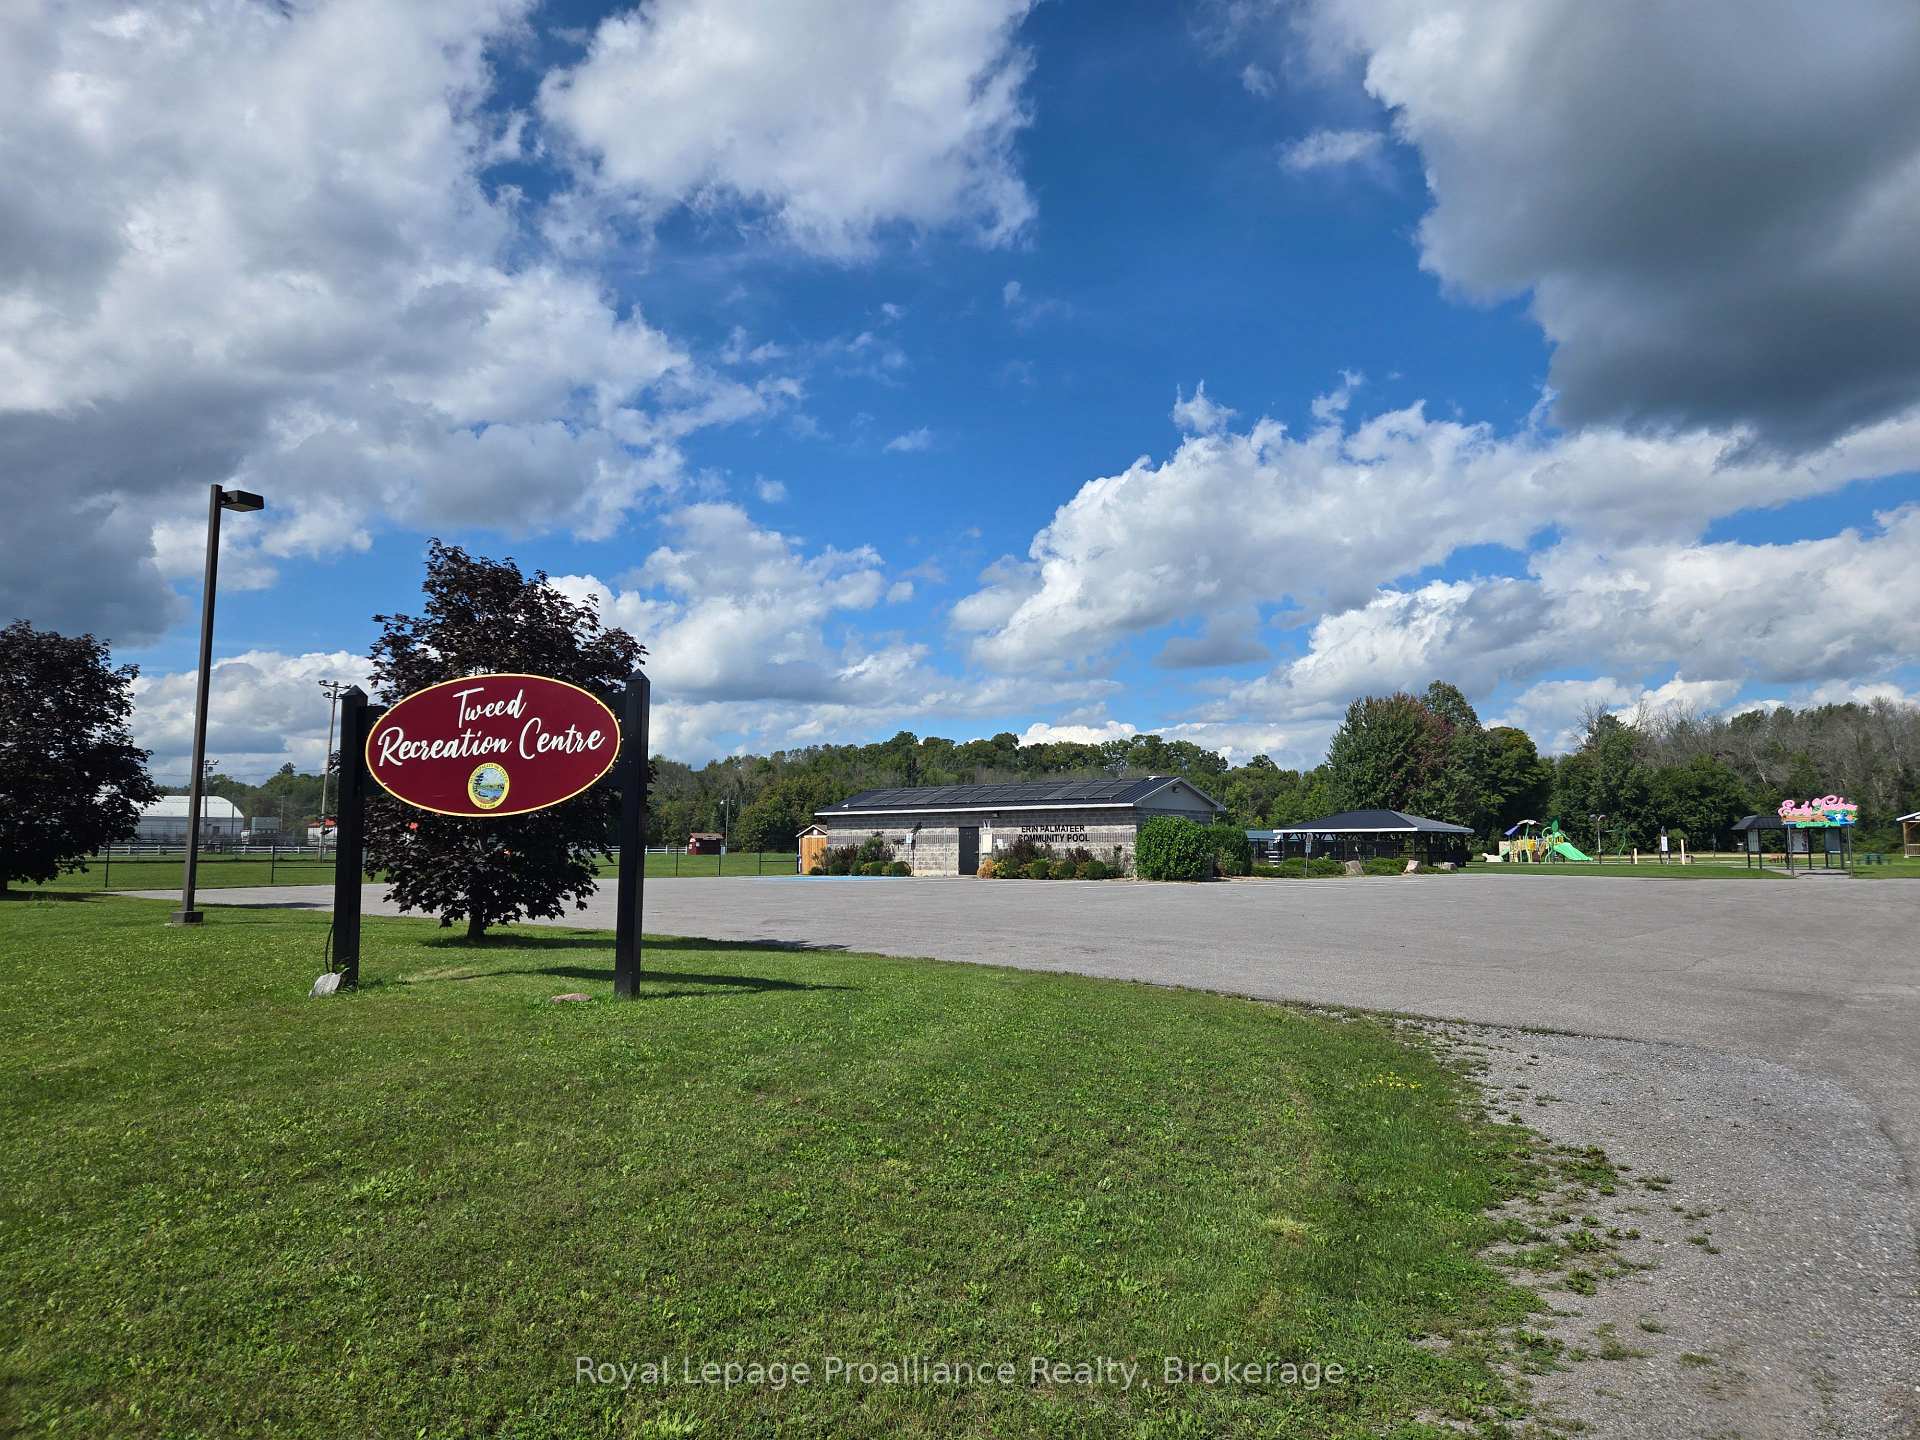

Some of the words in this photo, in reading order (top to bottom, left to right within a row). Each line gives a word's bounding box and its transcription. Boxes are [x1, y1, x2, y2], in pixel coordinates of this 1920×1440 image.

[453, 687, 526, 728] Tweed
[378, 726, 512, 767] Recreation
[519, 718, 605, 760] Centre
[1018, 834, 1065, 843] COMMUNITY
[1067, 834, 1090, 842] POOL
[1040, 825, 1085, 833] PALMATEER
